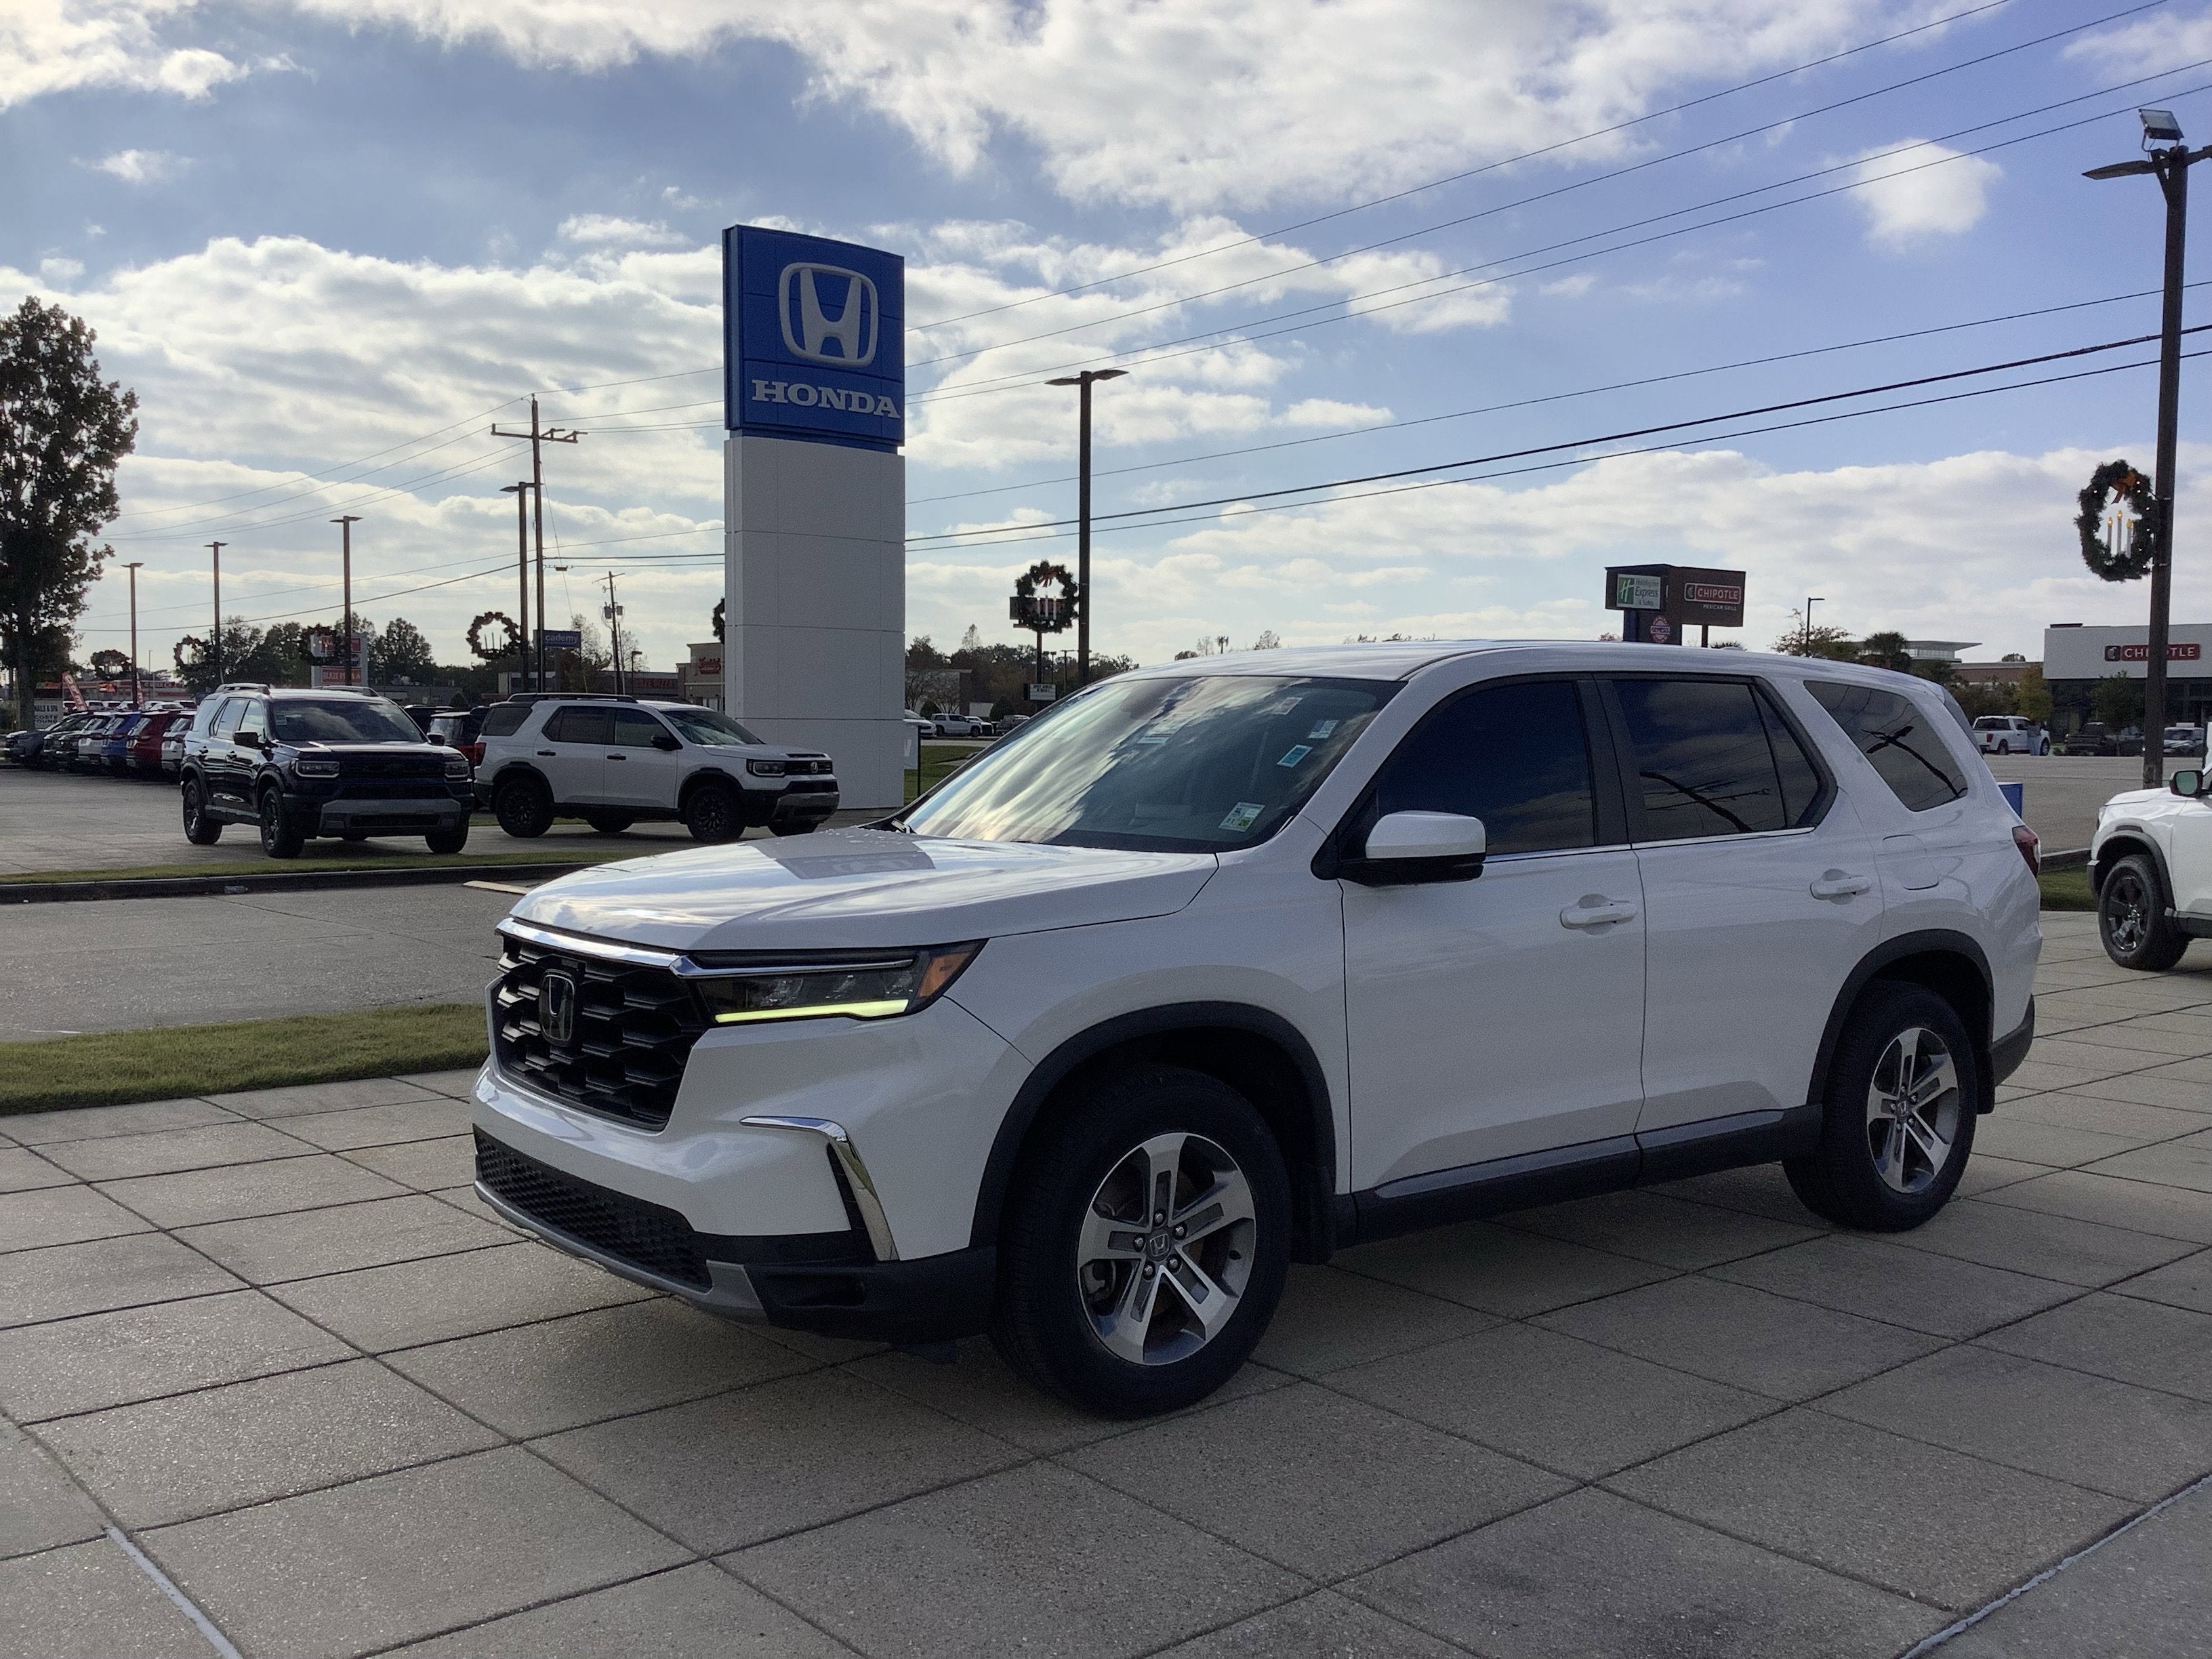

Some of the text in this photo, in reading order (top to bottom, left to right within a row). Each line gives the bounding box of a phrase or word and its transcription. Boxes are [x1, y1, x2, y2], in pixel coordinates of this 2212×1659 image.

[751, 379, 901, 419] HONDA
[1635, 586, 1658, 599] Express
[1697, 588, 1738, 600] CHIPOTLE
[545, 634, 578, 644] cademy
[2124, 647, 2195, 657] CHITLE
